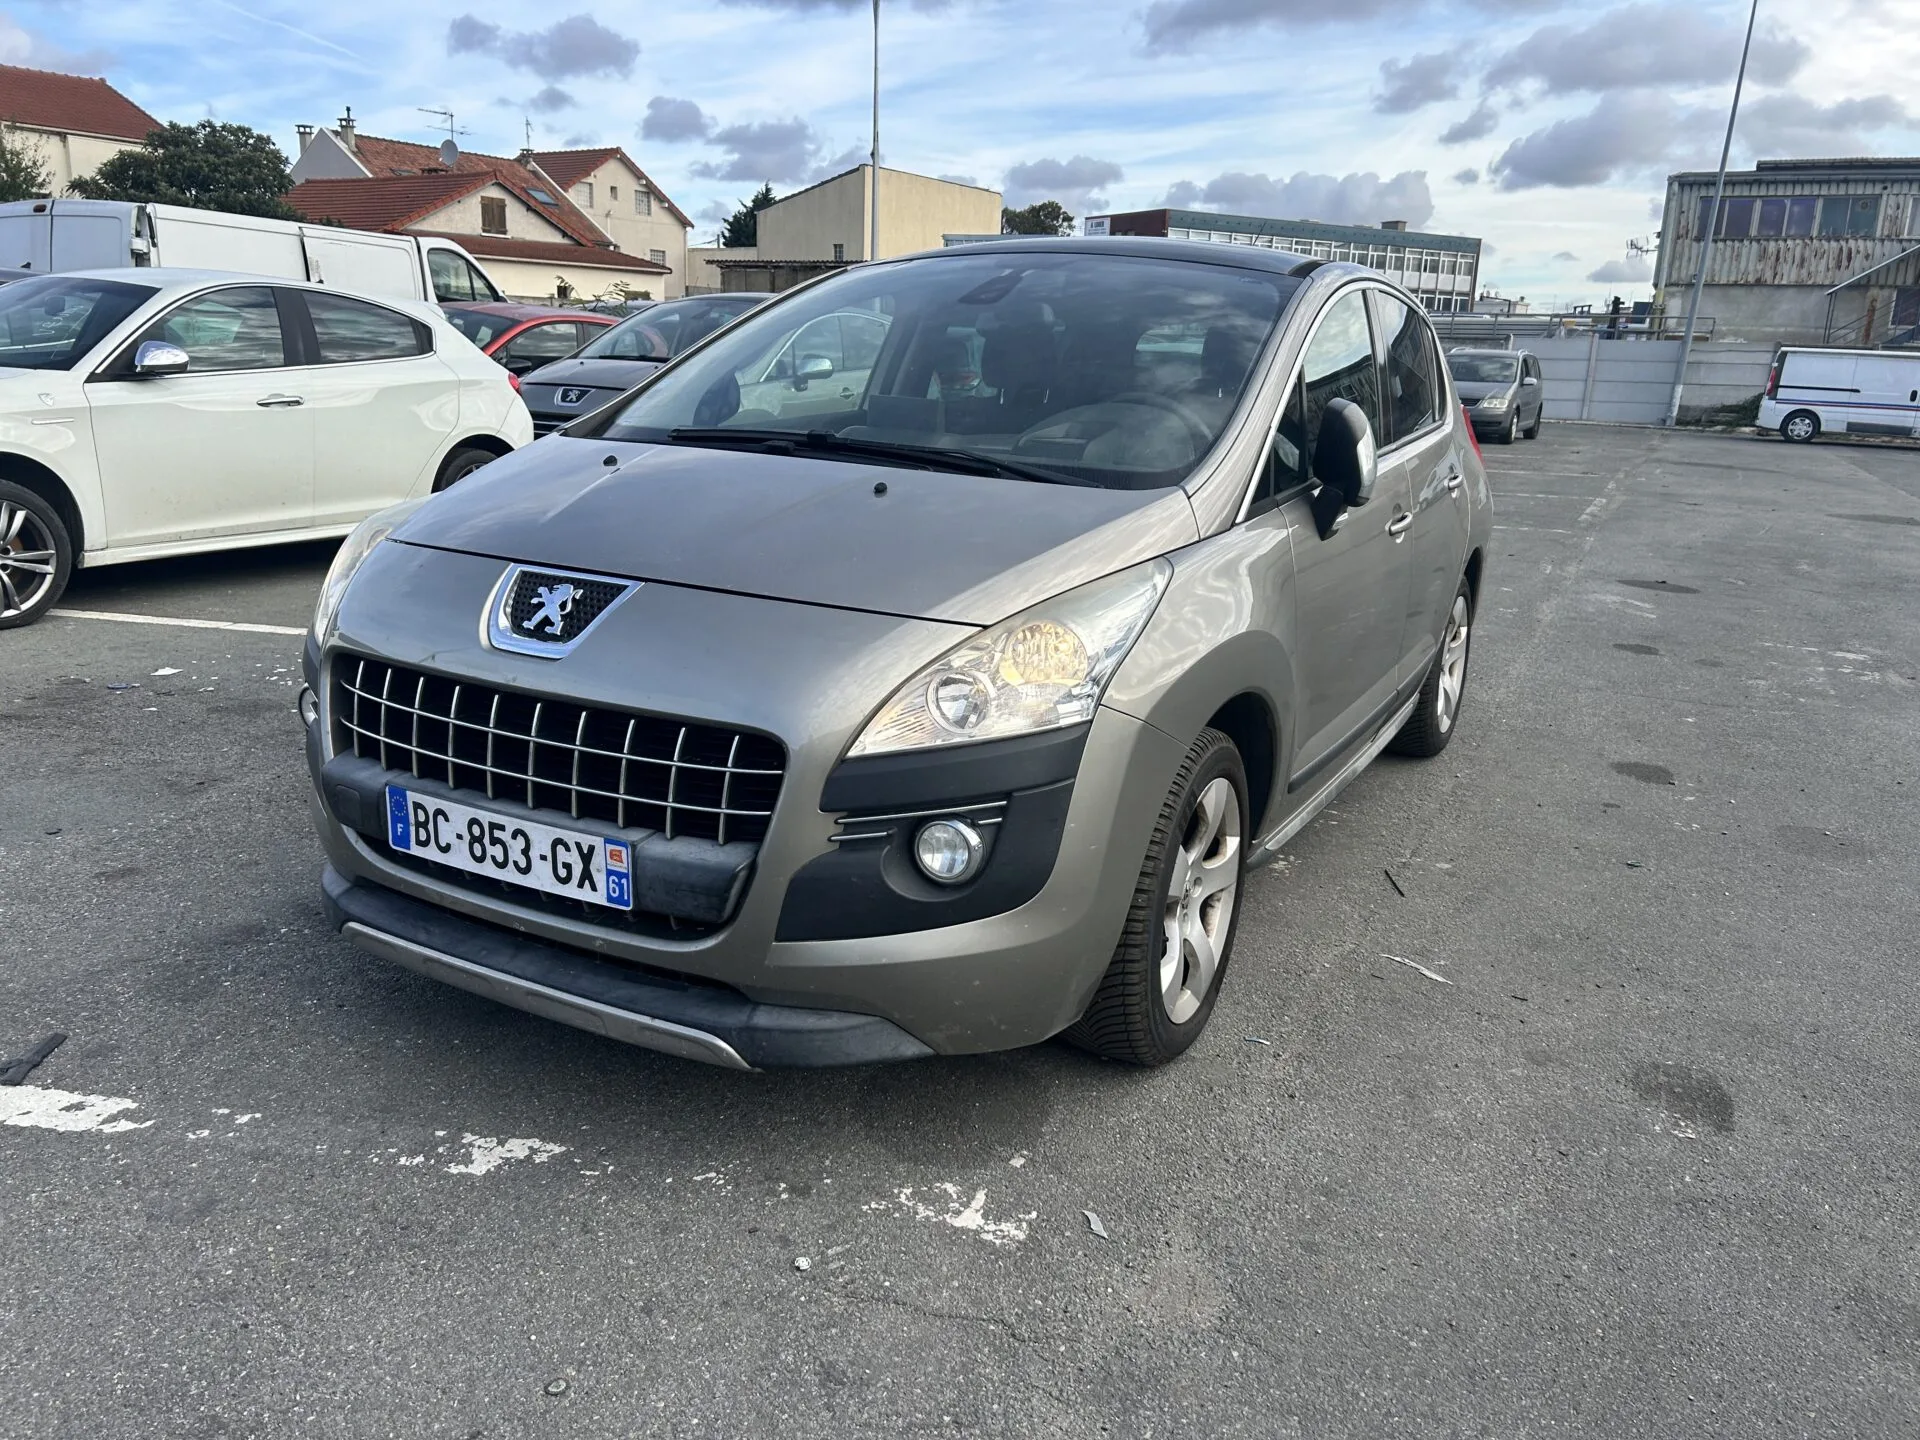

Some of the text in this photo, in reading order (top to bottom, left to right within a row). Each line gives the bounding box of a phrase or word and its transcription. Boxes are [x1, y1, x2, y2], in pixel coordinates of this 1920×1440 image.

[397, 823, 404, 836] F
[412, 800, 598, 892] BC-853-GX
[609, 875, 628, 900] 61
